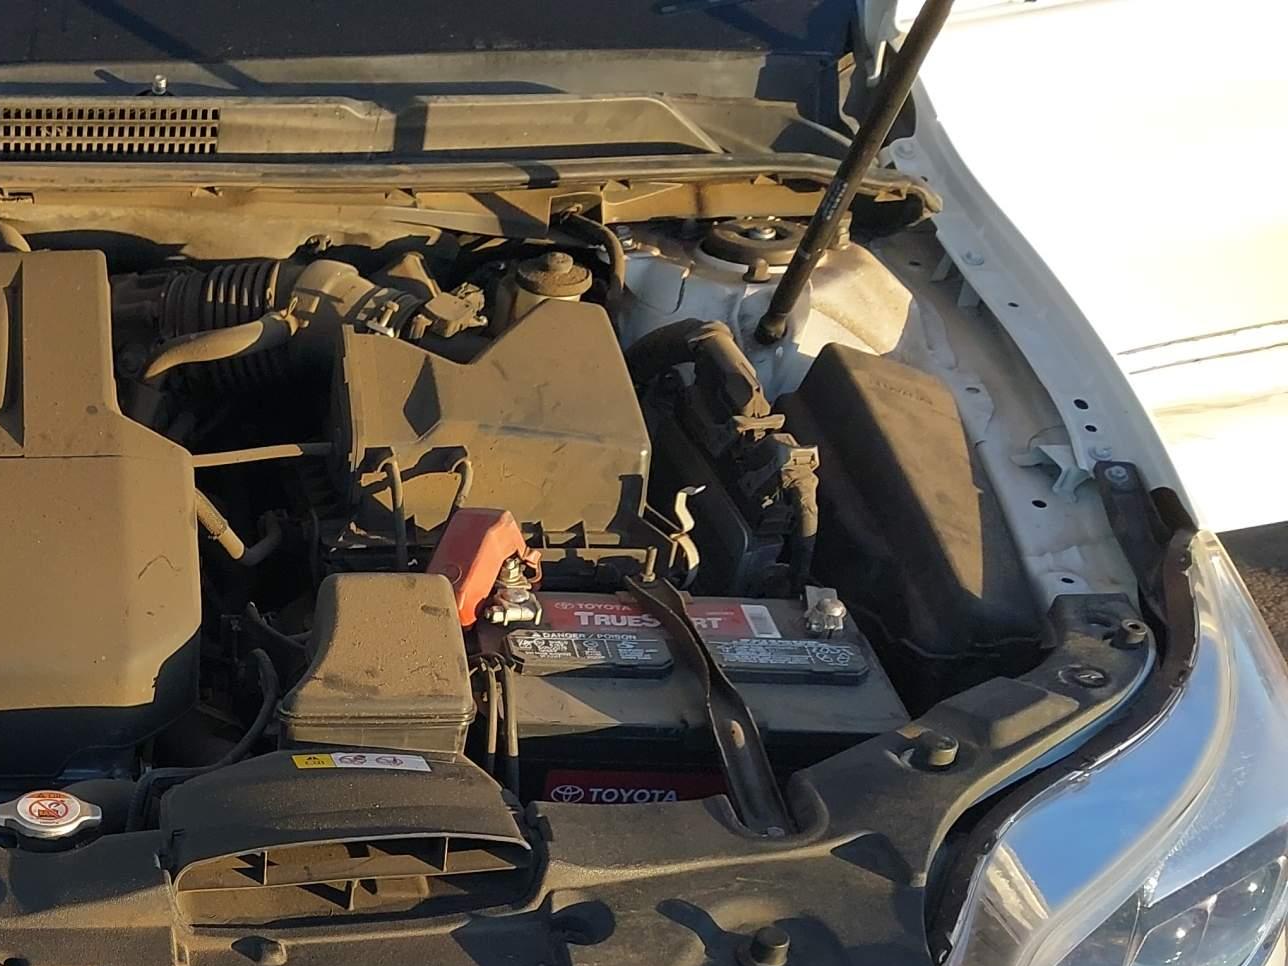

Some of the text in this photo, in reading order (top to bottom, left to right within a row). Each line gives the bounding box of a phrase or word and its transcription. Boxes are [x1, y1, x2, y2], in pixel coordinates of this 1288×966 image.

[576, 602, 632, 611] TOYOTA
[574, 611, 722, 628] TRUESRT
[589, 788, 678, 803] TOYOTA
